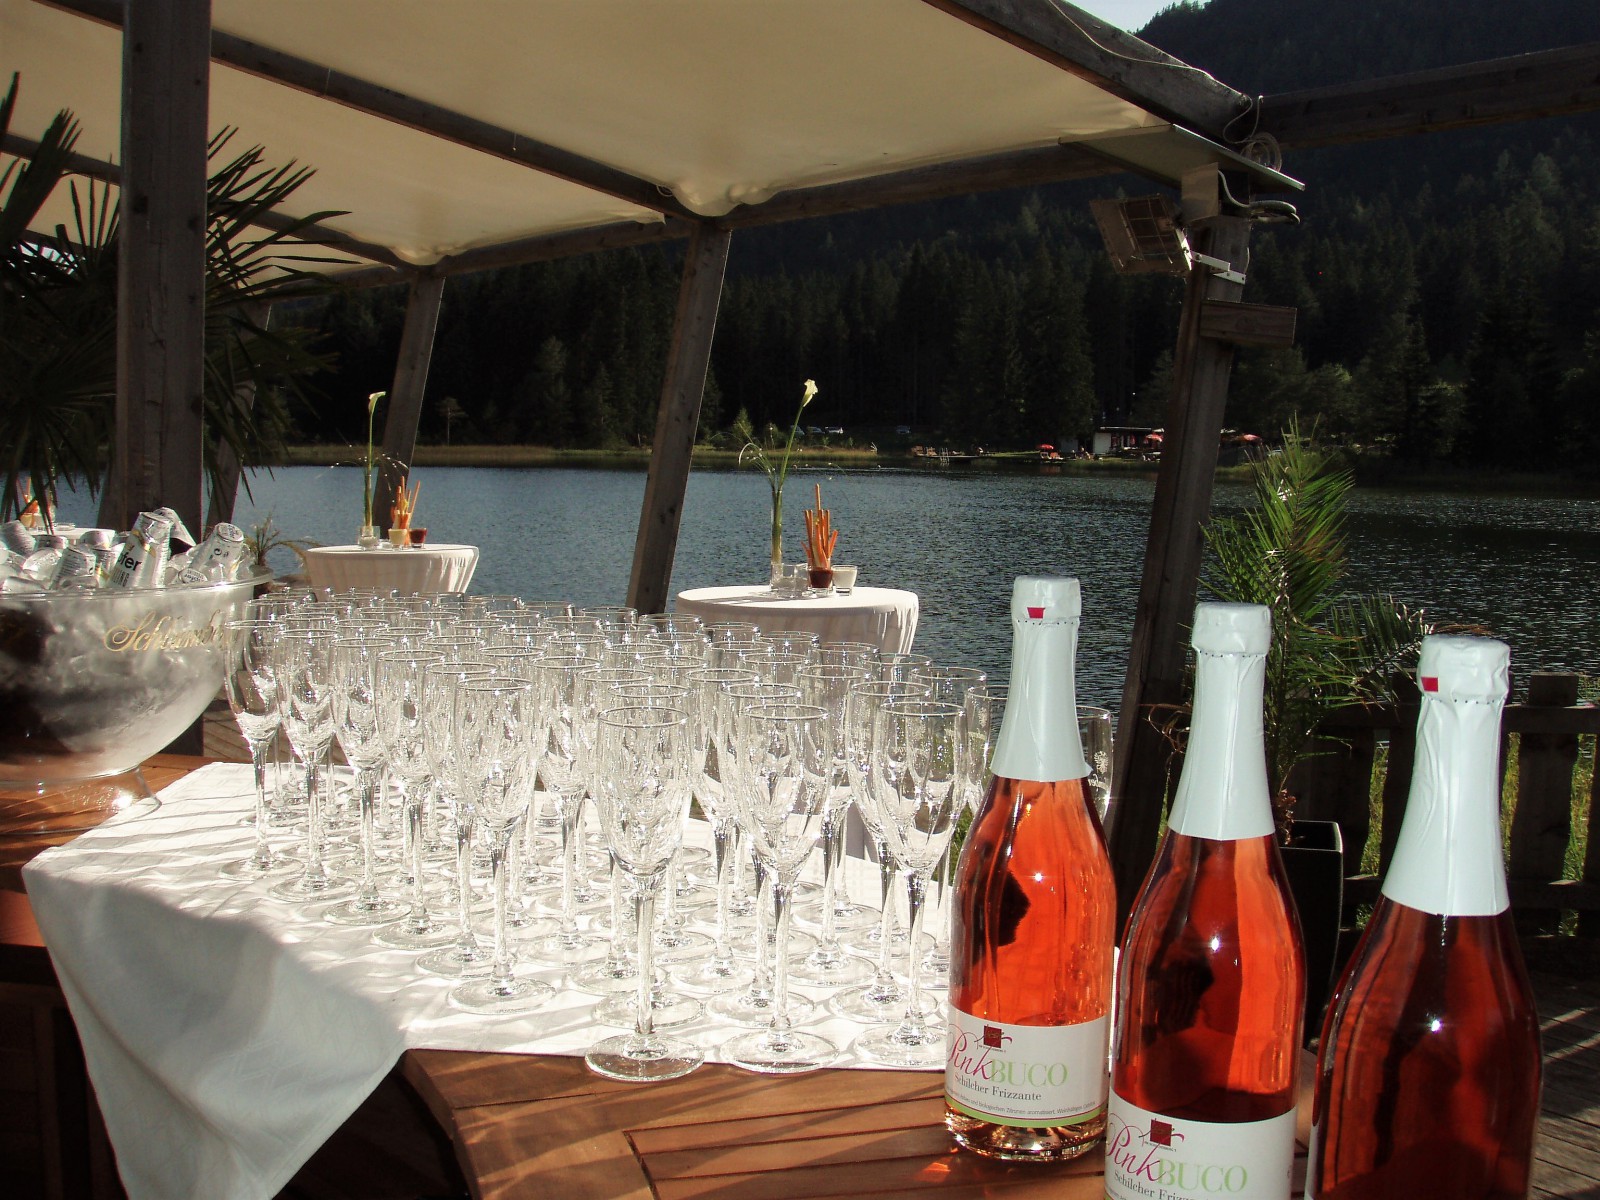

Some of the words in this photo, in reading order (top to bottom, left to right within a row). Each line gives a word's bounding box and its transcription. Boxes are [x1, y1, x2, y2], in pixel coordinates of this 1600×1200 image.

[947, 1023, 999, 1080] Pink
[991, 1059, 1068, 1088] BUCO
[954, 1071, 989, 1094] Schilcher
[992, 1085, 1042, 1101] Frizzante
[1105, 1112, 1167, 1182] Pink
[1158, 1157, 1248, 1193] BUCO
[1113, 1170, 1156, 1197] Schilcher
